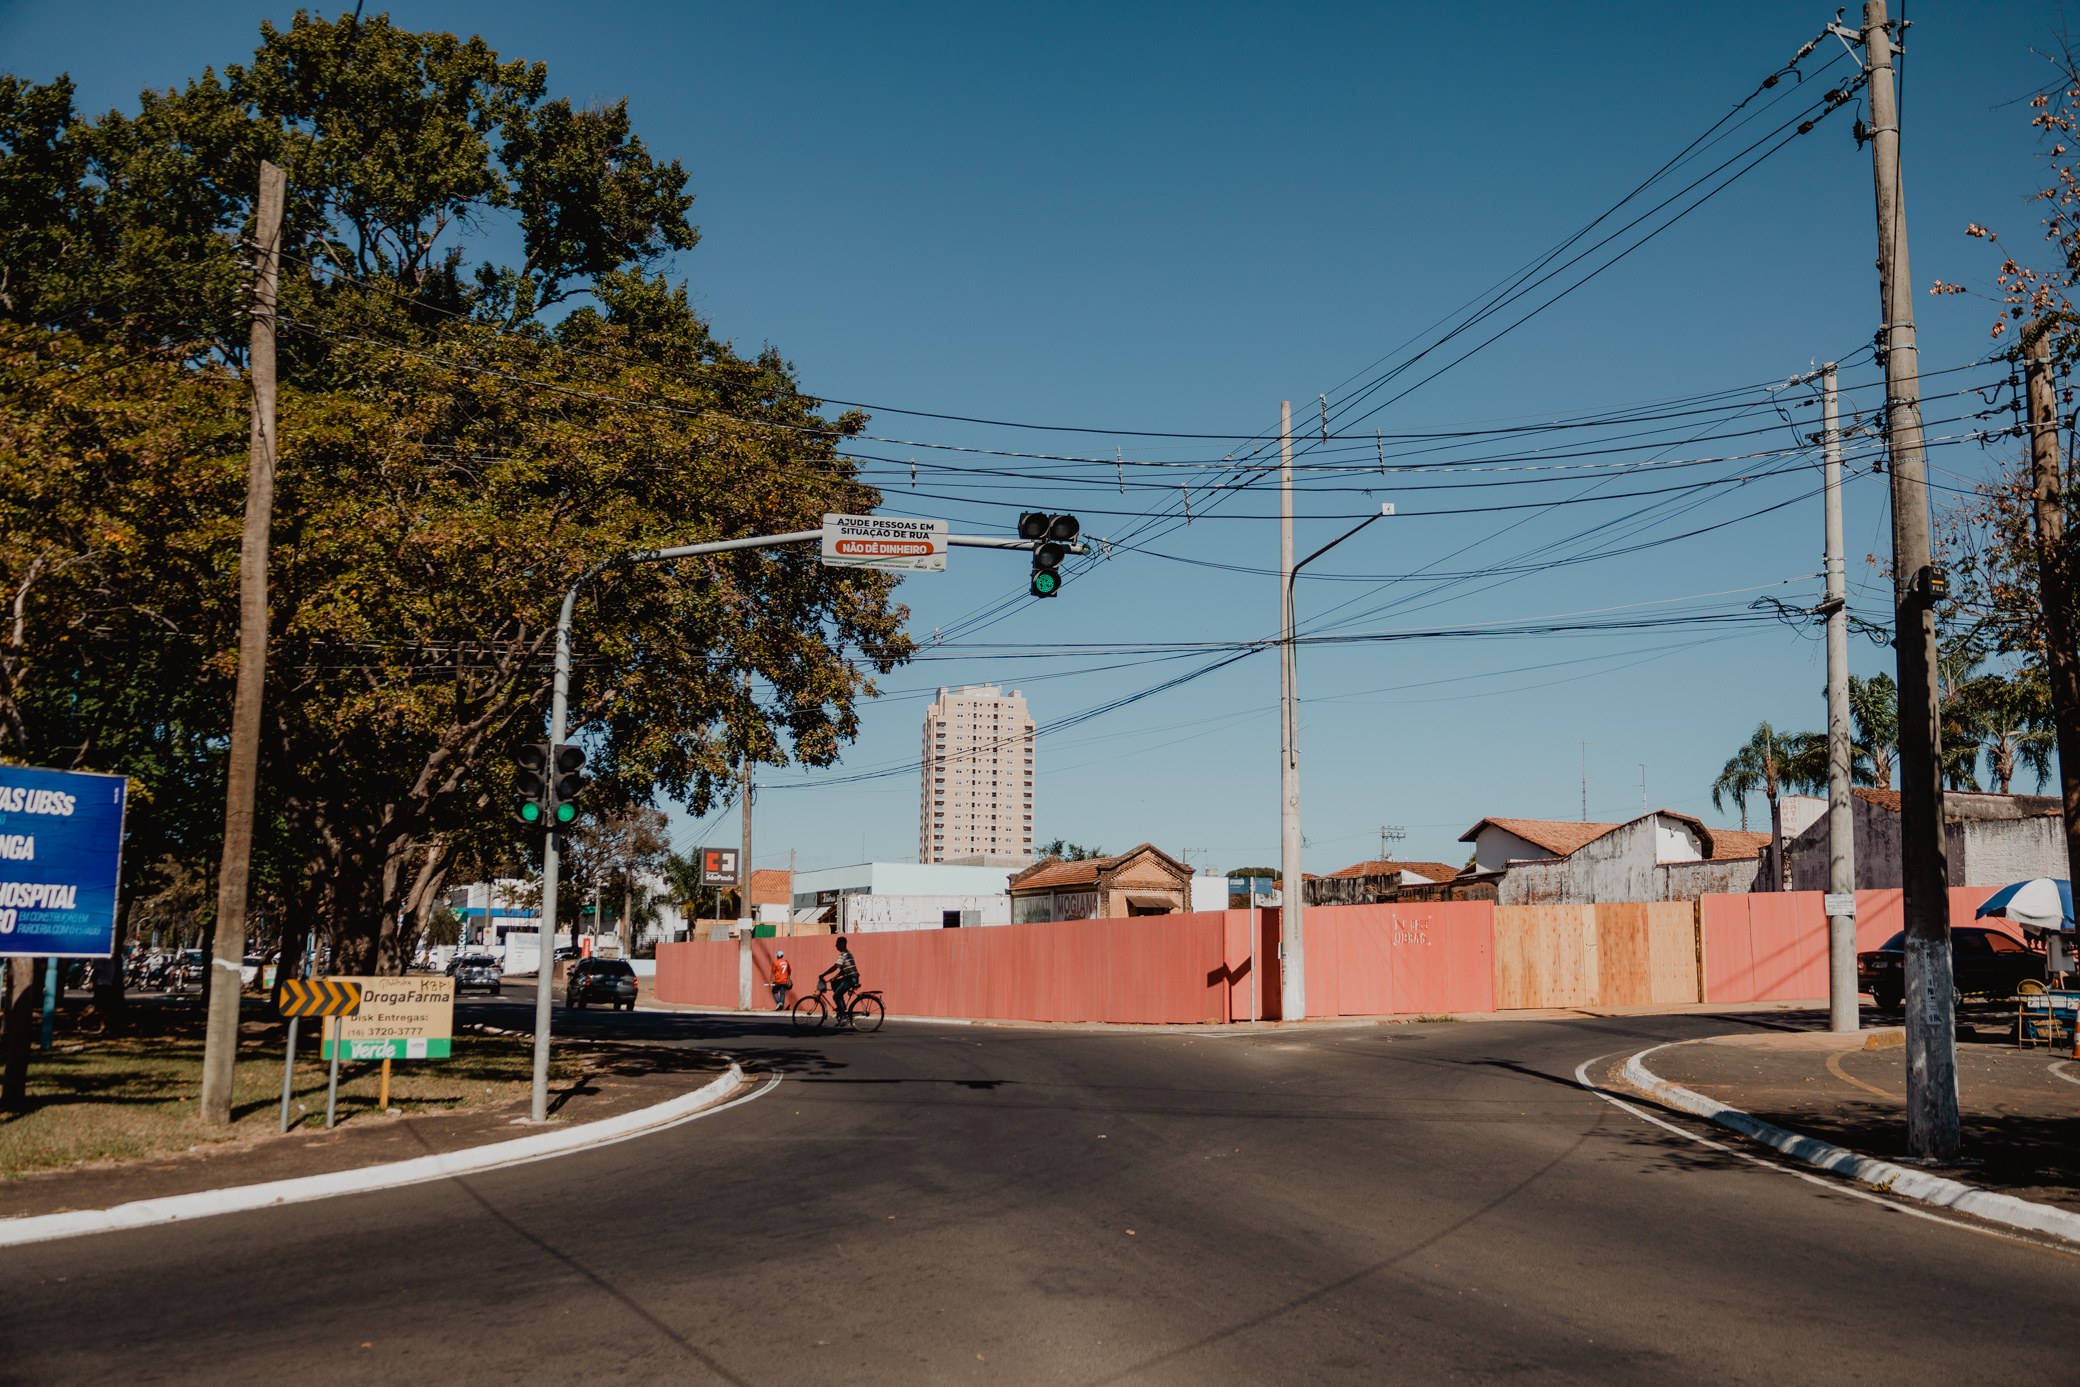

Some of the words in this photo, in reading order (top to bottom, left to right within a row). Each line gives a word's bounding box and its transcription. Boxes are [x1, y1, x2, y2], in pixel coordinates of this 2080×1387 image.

[837, 518, 870, 527] AJUDE
[873, 520, 917, 530] PESSOAS
[920, 523, 934, 531] EM
[841, 527, 890, 538] SITUAÇÃO
[893, 530, 907, 538] DE
[909, 531, 930, 540] RUA
[842, 541, 864, 553] NÃO
[865, 542, 879, 554] DÊ
[880, 543, 928, 555] DINHEIRO
[25, 789, 76, 816] UBSs
[1057, 893, 1098, 915] MOGIANA
[1394, 932, 1426, 944] OBRAS
[781, 965, 788, 974] 7
[363, 990, 450, 1006] DrogaFarma
[377, 1013, 429, 1023] Entregas:
[347, 1029, 365, 1038] (16)
[367, 1027, 423, 1036] 3720-3777
[350, 1038, 397, 1059] Verde
